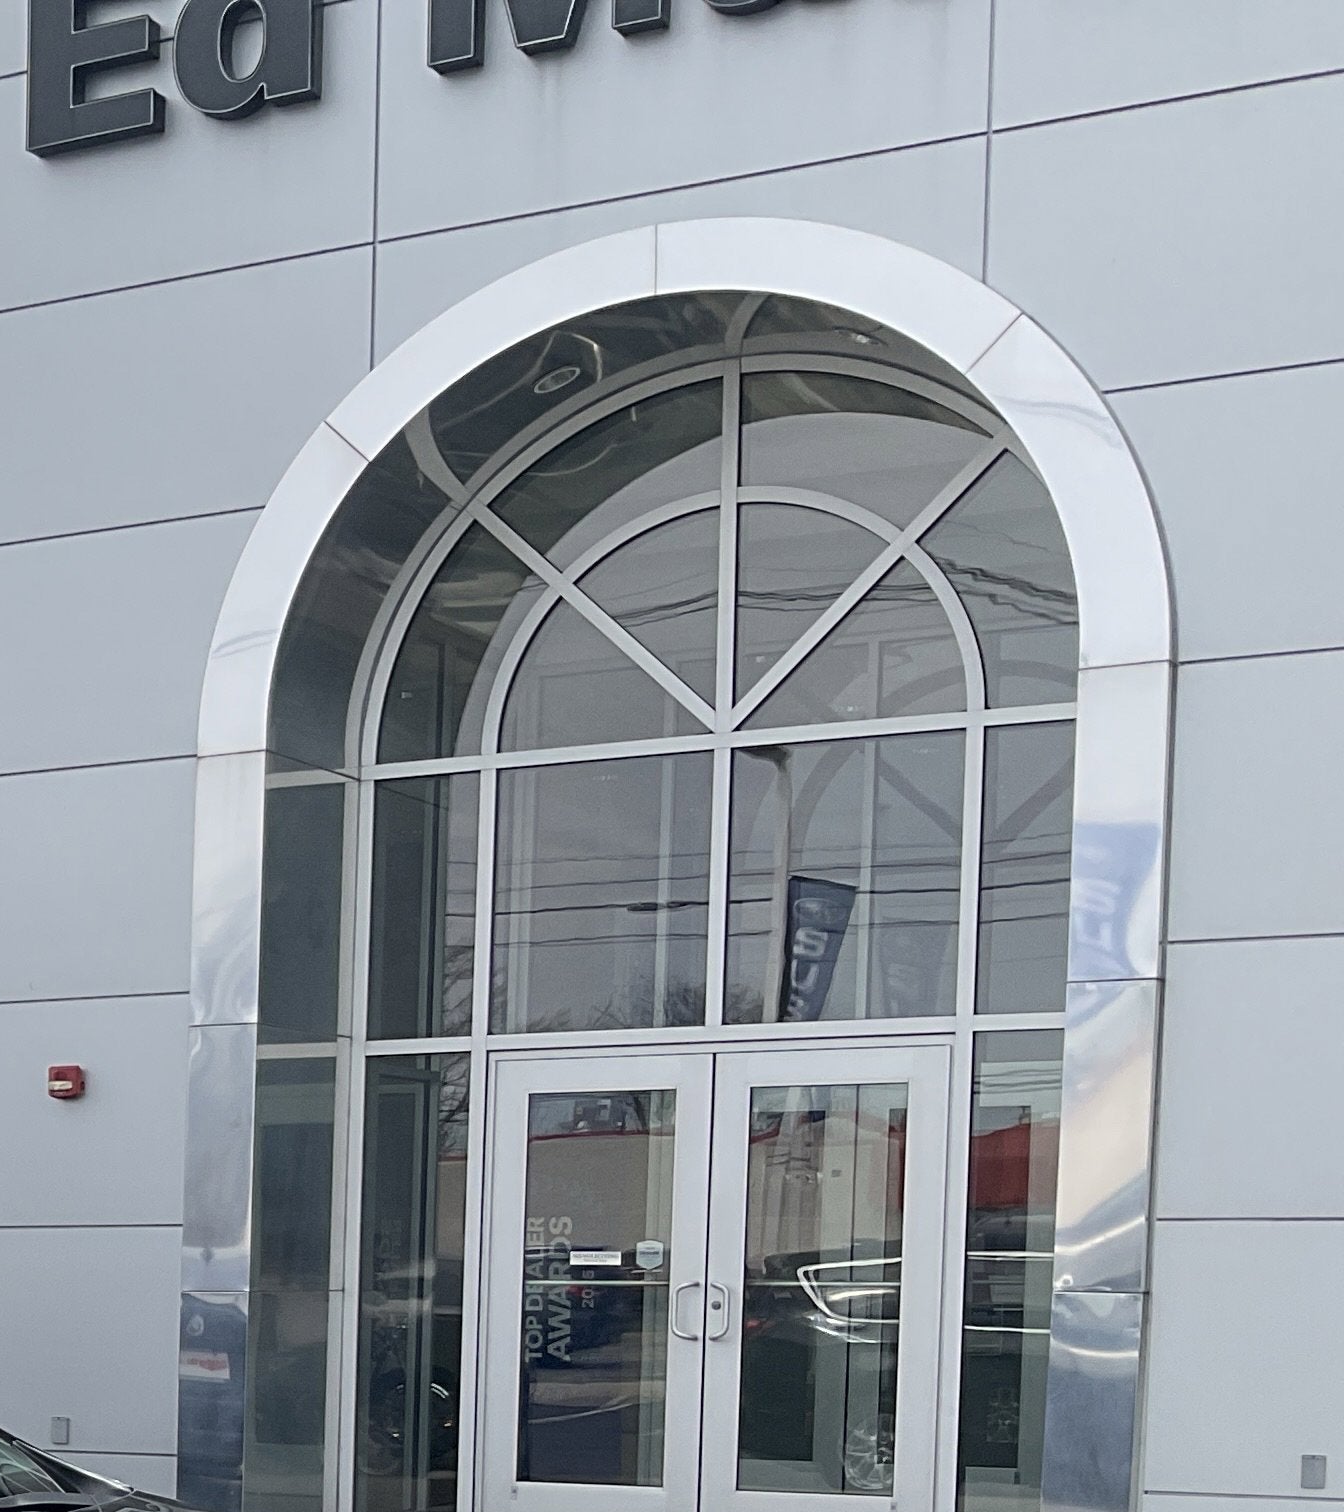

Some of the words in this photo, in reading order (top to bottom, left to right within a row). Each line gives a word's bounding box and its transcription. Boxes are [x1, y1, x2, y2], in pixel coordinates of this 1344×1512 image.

[525, 1216, 545, 1312] DEALER
[547, 1215, 573, 1362] AWARDS
[525, 1315, 543, 1364] TOP
